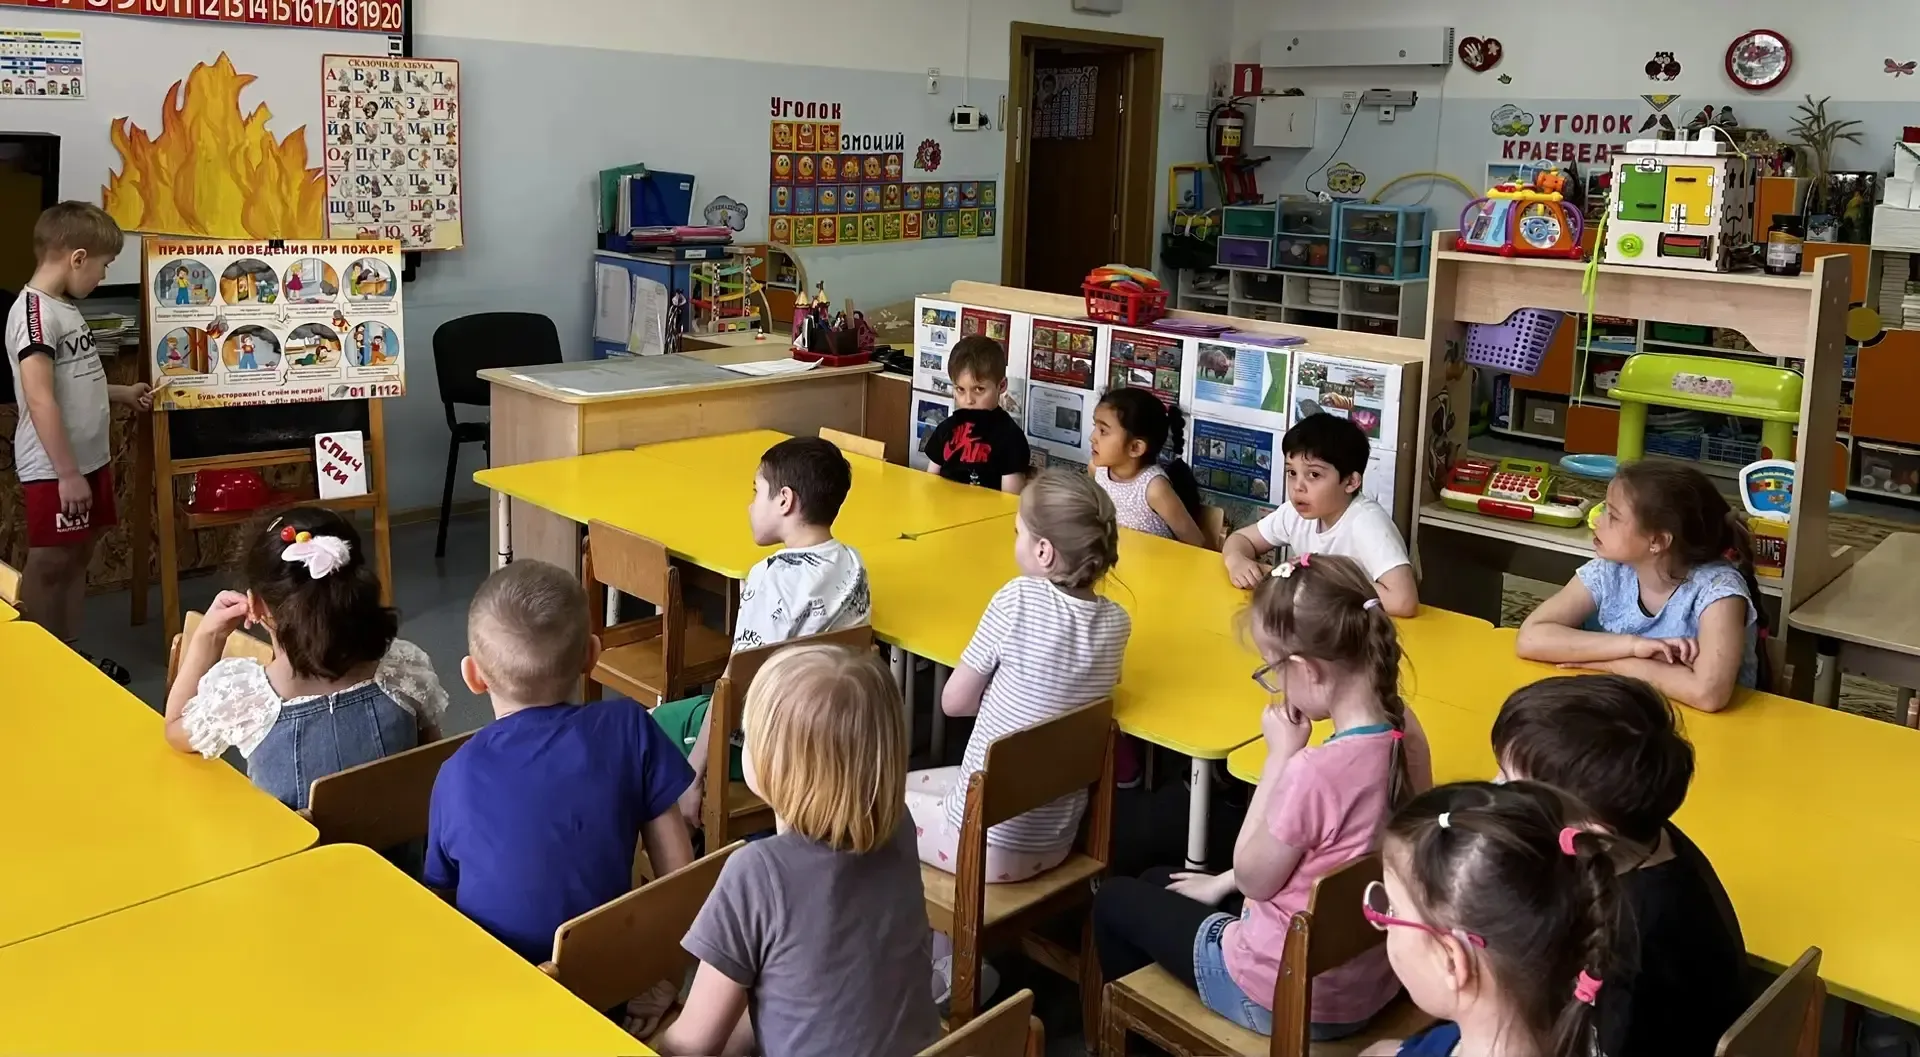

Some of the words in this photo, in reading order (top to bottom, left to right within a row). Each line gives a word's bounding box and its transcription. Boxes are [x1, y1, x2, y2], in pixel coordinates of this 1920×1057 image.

[272, 0, 291, 20] 15
[295, 0, 313, 22] 16
[315, 0, 336, 24] 17
[337, 0, 358, 25] 18
[360, 1, 380, 27] 19
[382, 3, 402, 28] 20
[348, 59, 400, 68] СКАЗОЧНАЯ
[402, 62, 434, 70] АЗБУКА
[354, 68, 364, 81] Б
[406, 70, 416, 82] Г
[432, 71, 443, 85] Д
[355, 93, 364, 108] Ё
[380, 96, 394, 109] Ж
[406, 97, 415, 109] З
[433, 98, 445, 110] И
[327, 121, 339, 135] Й
[380, 122, 392, 135] Л
[1539, 114, 1633, 134] УГОЛОК
[356, 148, 367, 160] П
[356, 174, 369, 186] Ф
[435, 174, 445, 185] Ч
[330, 201, 345, 213] Ш
[357, 201, 372, 215] Щ
[383, 200, 395, 212] Ъ
[436, 199, 446, 211] Ь
[385, 225, 401, 238] Ю
[412, 225, 422, 237] Я
[158, 244, 224, 256] ПРАВИЛА
[228, 245, 308, 256] ПОВЕДЕНИЯ
[312, 245, 338, 255] ПРИ
[341, 245, 394, 255] ПОЖАРЕ
[350, 386, 364, 397] 01
[377, 384, 400, 396] 112
[319, 436, 363, 472] СПИЧ
[321, 461, 349, 486] КИ
